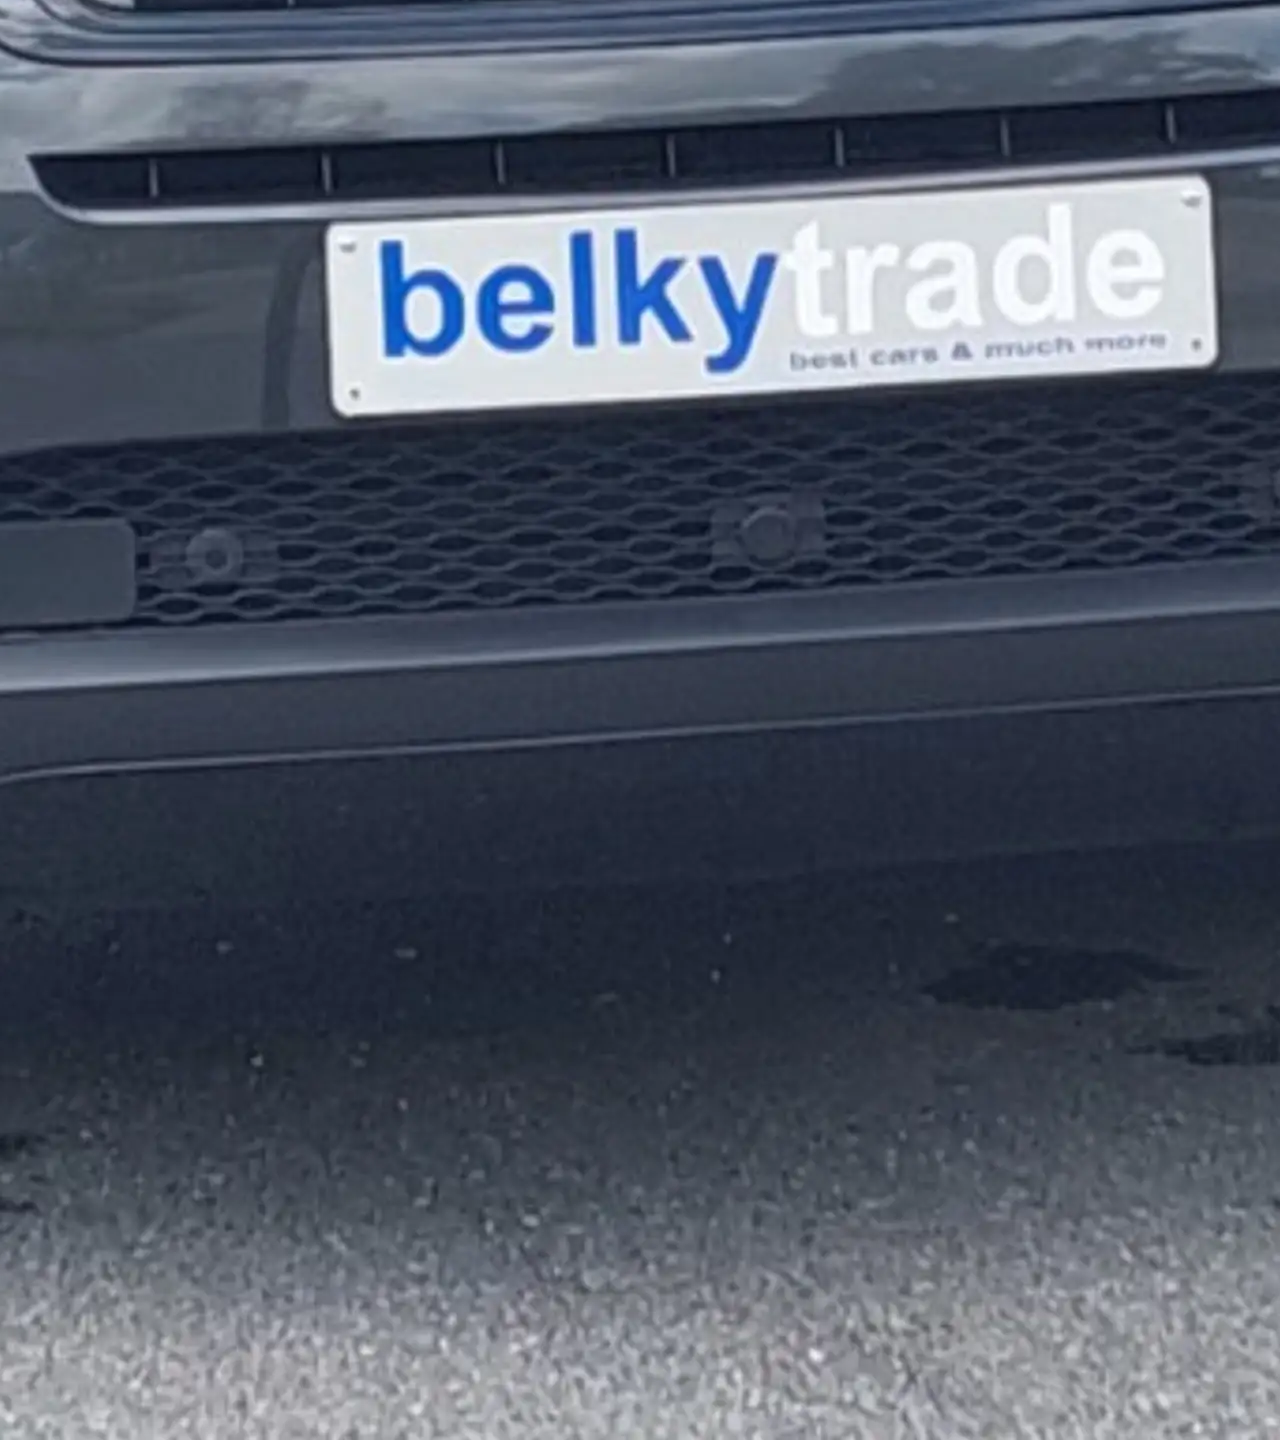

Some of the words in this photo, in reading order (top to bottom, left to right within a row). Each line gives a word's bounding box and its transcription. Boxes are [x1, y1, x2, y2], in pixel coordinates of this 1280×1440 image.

[378, 203, 1167, 374] belkytrade
[790, 346, 859, 372] best
[870, 347, 939, 366] cars
[984, 336, 1075, 359] much
[1084, 333, 1168, 352] more
